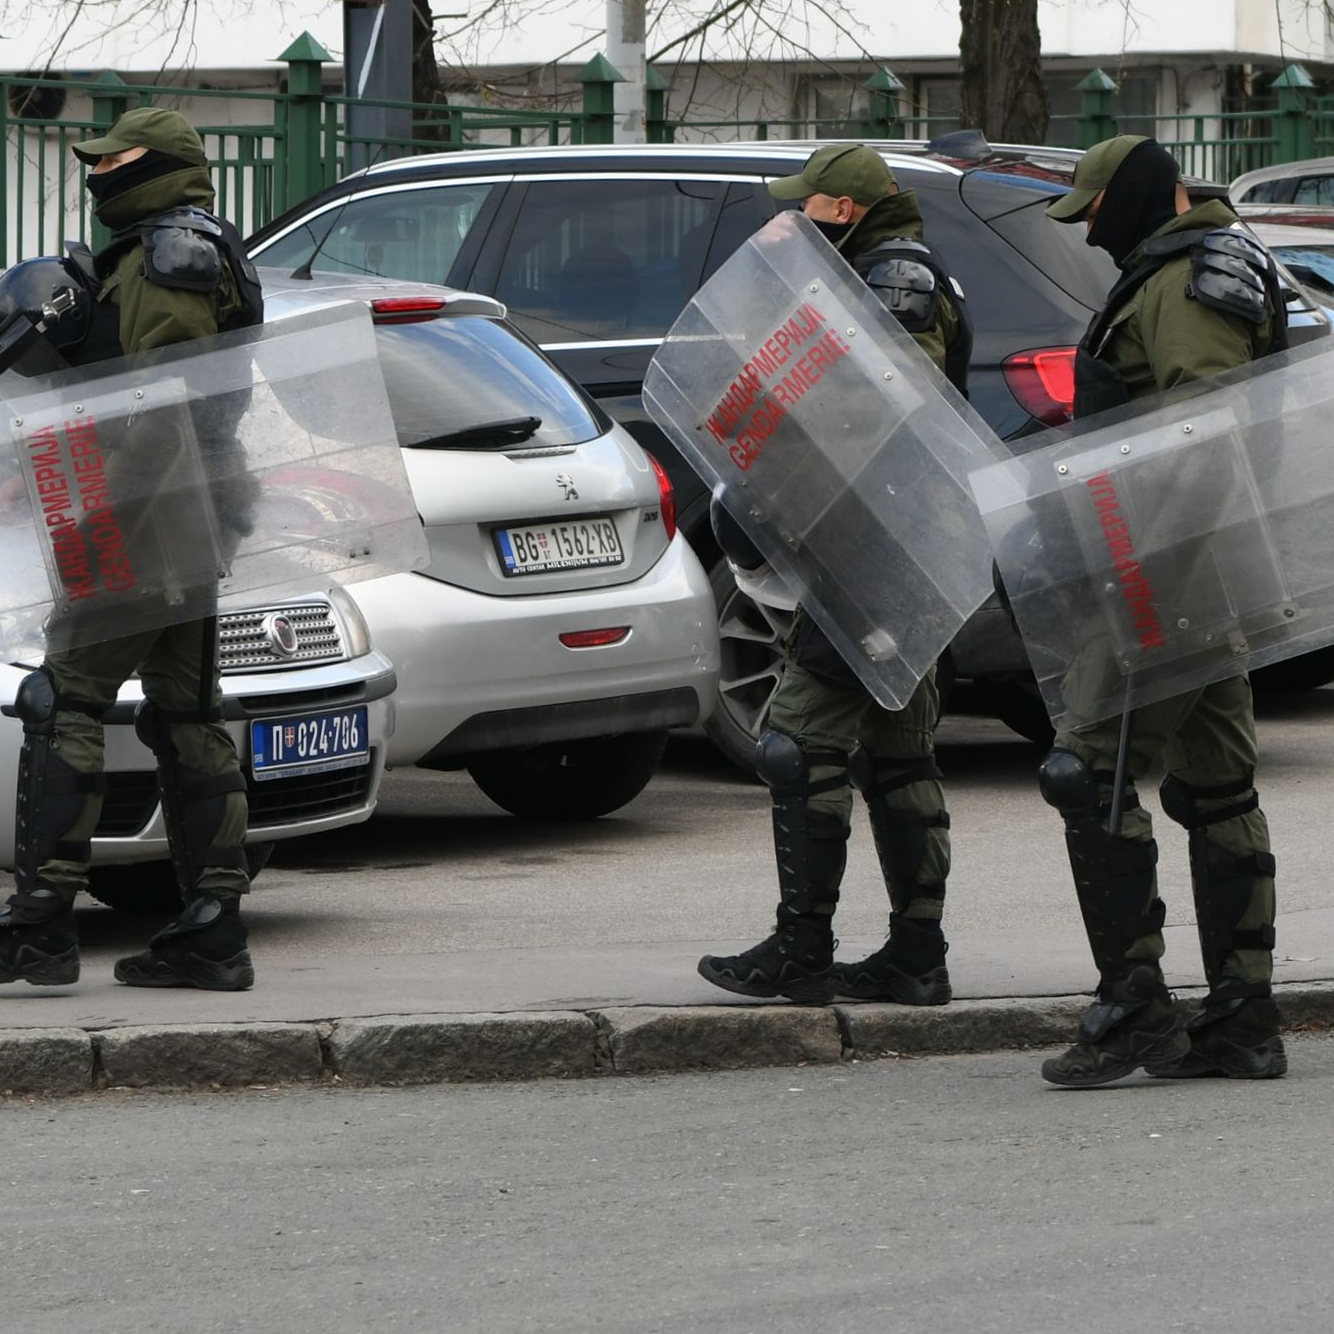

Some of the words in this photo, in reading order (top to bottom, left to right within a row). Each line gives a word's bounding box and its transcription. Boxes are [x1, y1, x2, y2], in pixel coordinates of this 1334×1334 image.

[705, 301, 827, 446] ЖАНДАРМЕРИЈА
[728, 328, 851, 472] GENDARMERIE
[27, 424, 95, 602] ЖАНДАРМЕРИЈА
[64, 415, 137, 593] GENDARMERIE
[512, 531, 540, 564] BG
[527, 564, 546, 572] CENTAR
[272, 725, 283, 761] П
